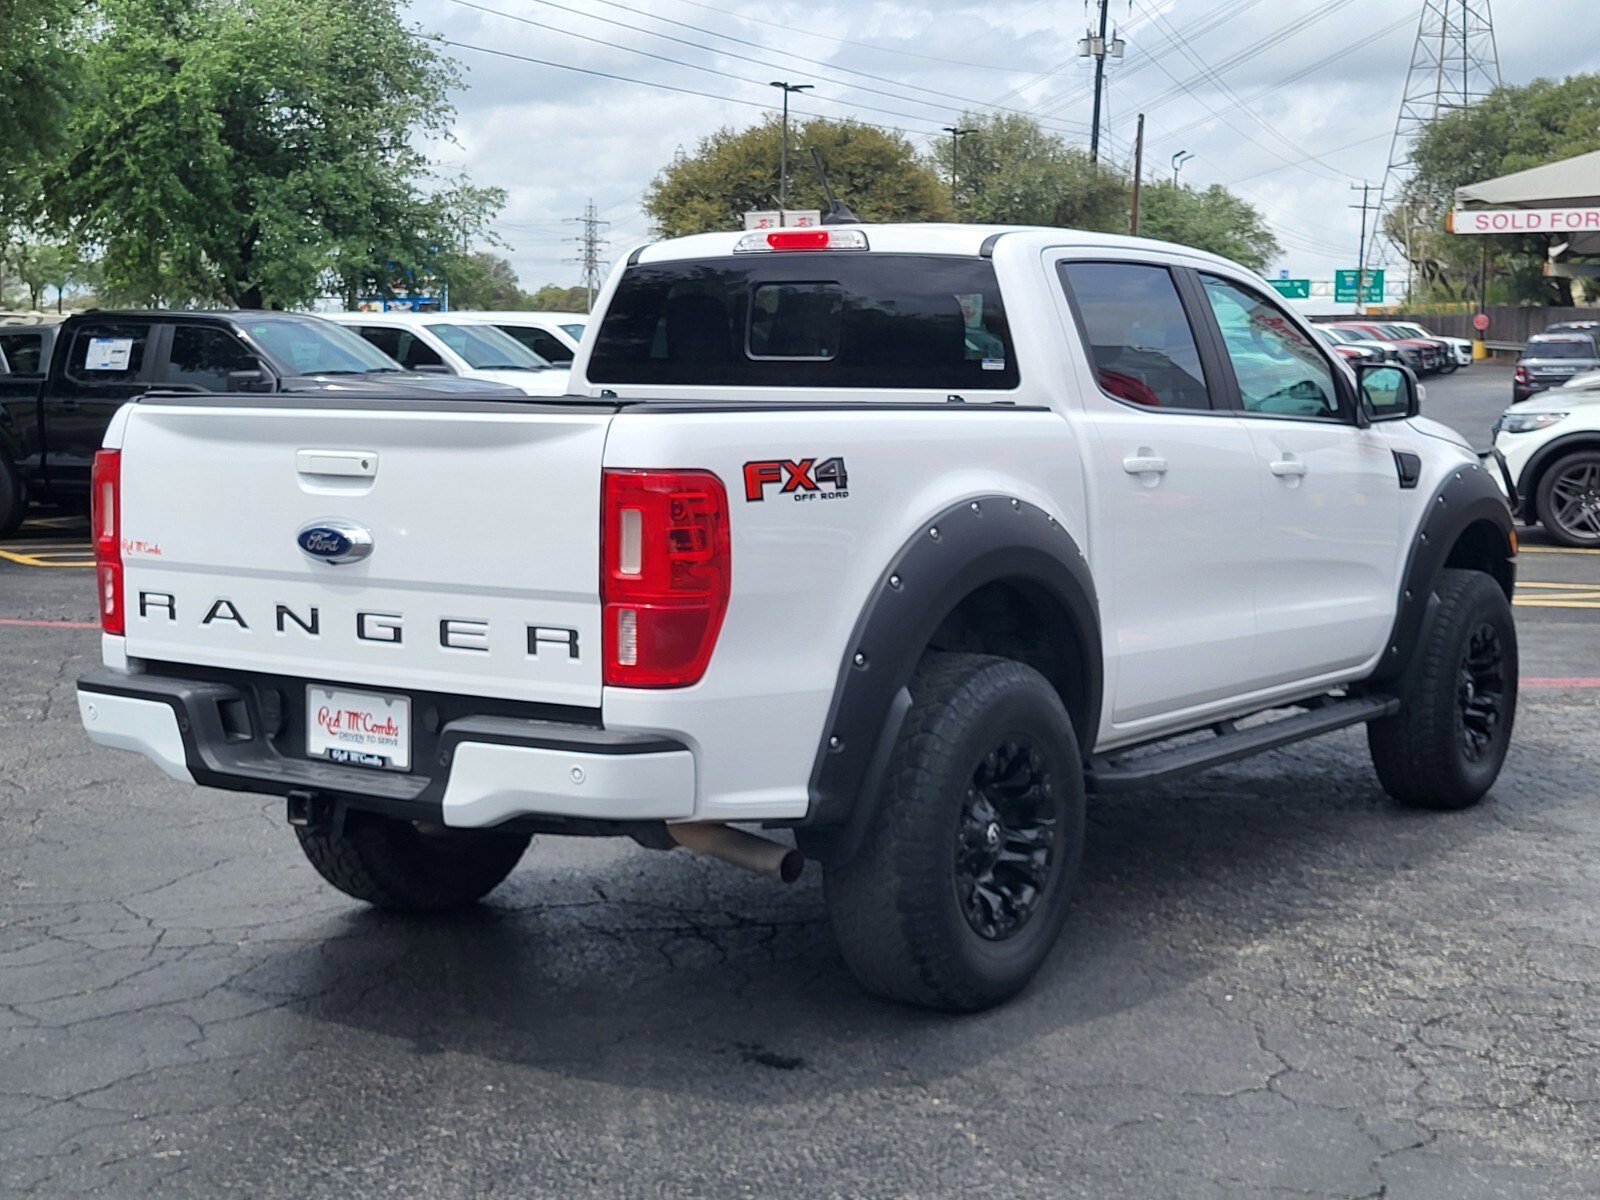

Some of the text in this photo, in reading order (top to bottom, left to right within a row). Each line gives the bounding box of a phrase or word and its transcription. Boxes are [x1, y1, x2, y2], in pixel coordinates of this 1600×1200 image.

[1475, 211, 1600, 230] SOLD FOR
[743, 457, 848, 503] FX4
[793, 491, 849, 502] OFF ROAD
[307, 531, 340, 552] Ford
[138, 590, 580, 659] RANGER
[318, 705, 399, 737] Red McCombs
[339, 731, 399, 747] DRIVEN TO SERVE
